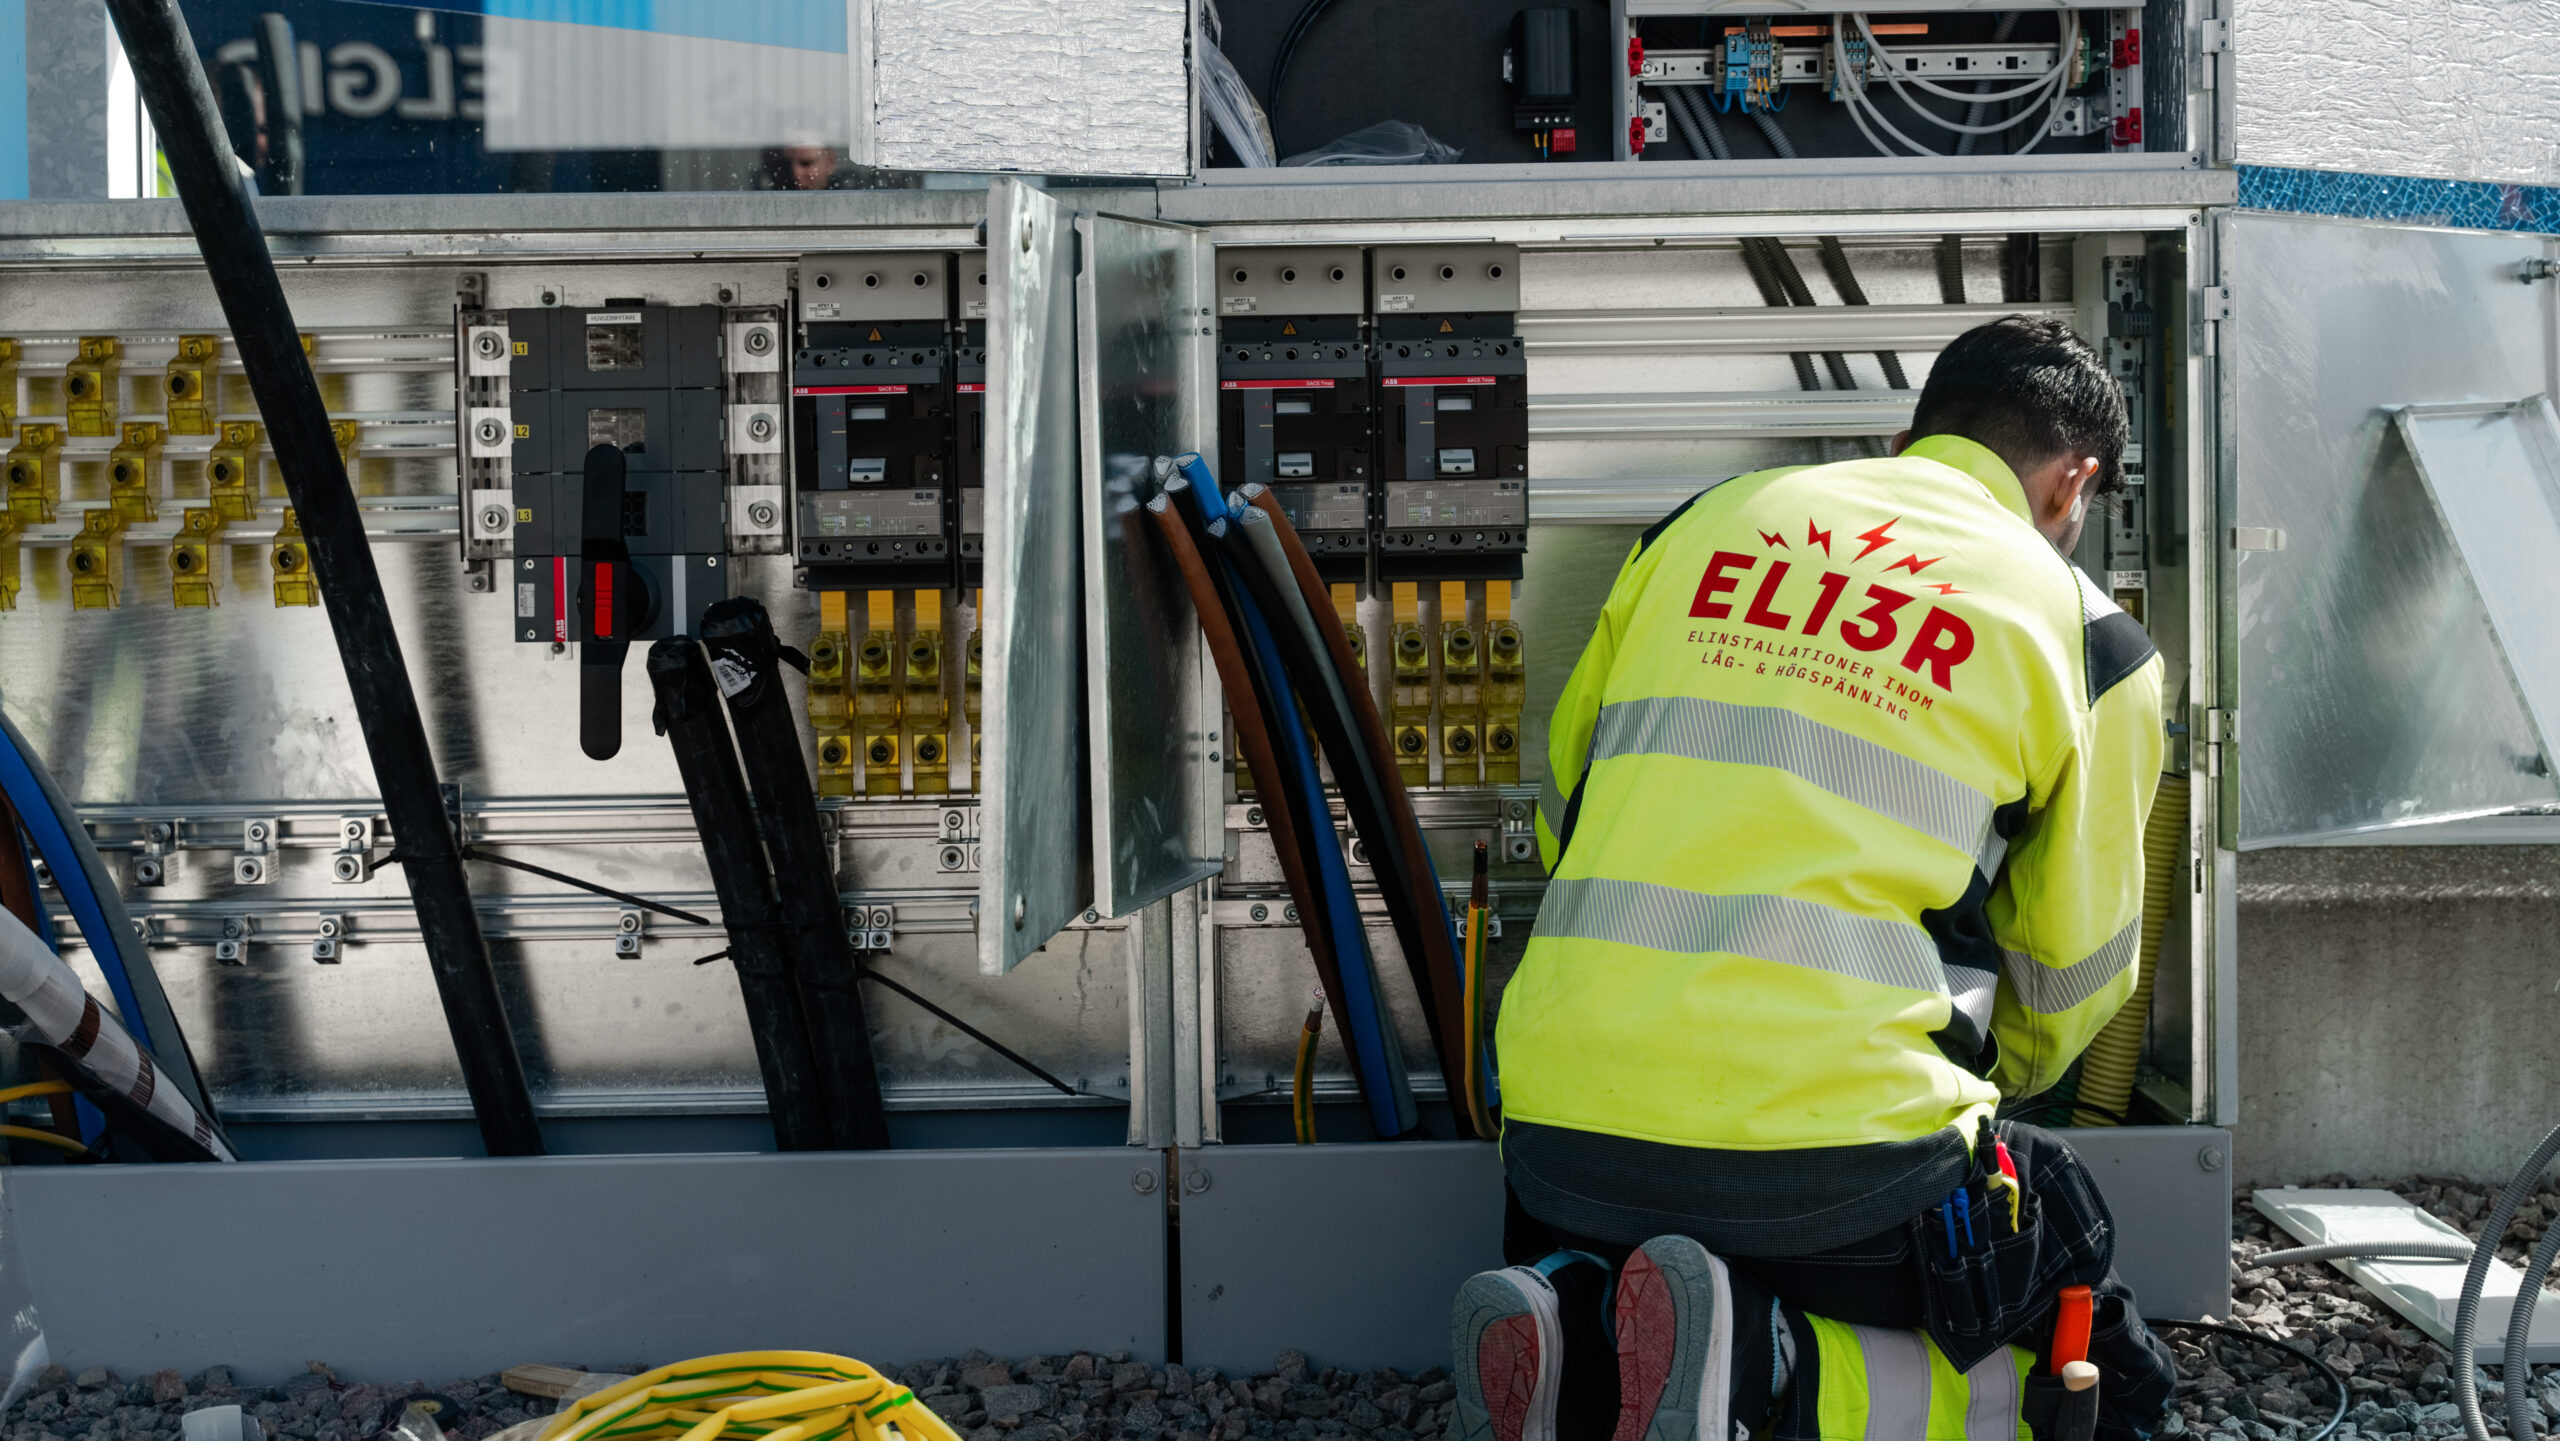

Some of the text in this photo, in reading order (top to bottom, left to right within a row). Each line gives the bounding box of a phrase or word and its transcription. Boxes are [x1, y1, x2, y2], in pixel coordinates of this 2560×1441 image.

[514, 343, 526, 354] L1
[516, 426, 528, 437] L2
[517, 510, 530, 521] L3
[556, 619, 565, 639] ABB
[1688, 551, 1975, 693] EL13R
[1687, 630, 1934, 711] ELINSTALLATIONER INOM
[1701, 650, 1909, 721] LÅG- & HÖGSPÄNNING
